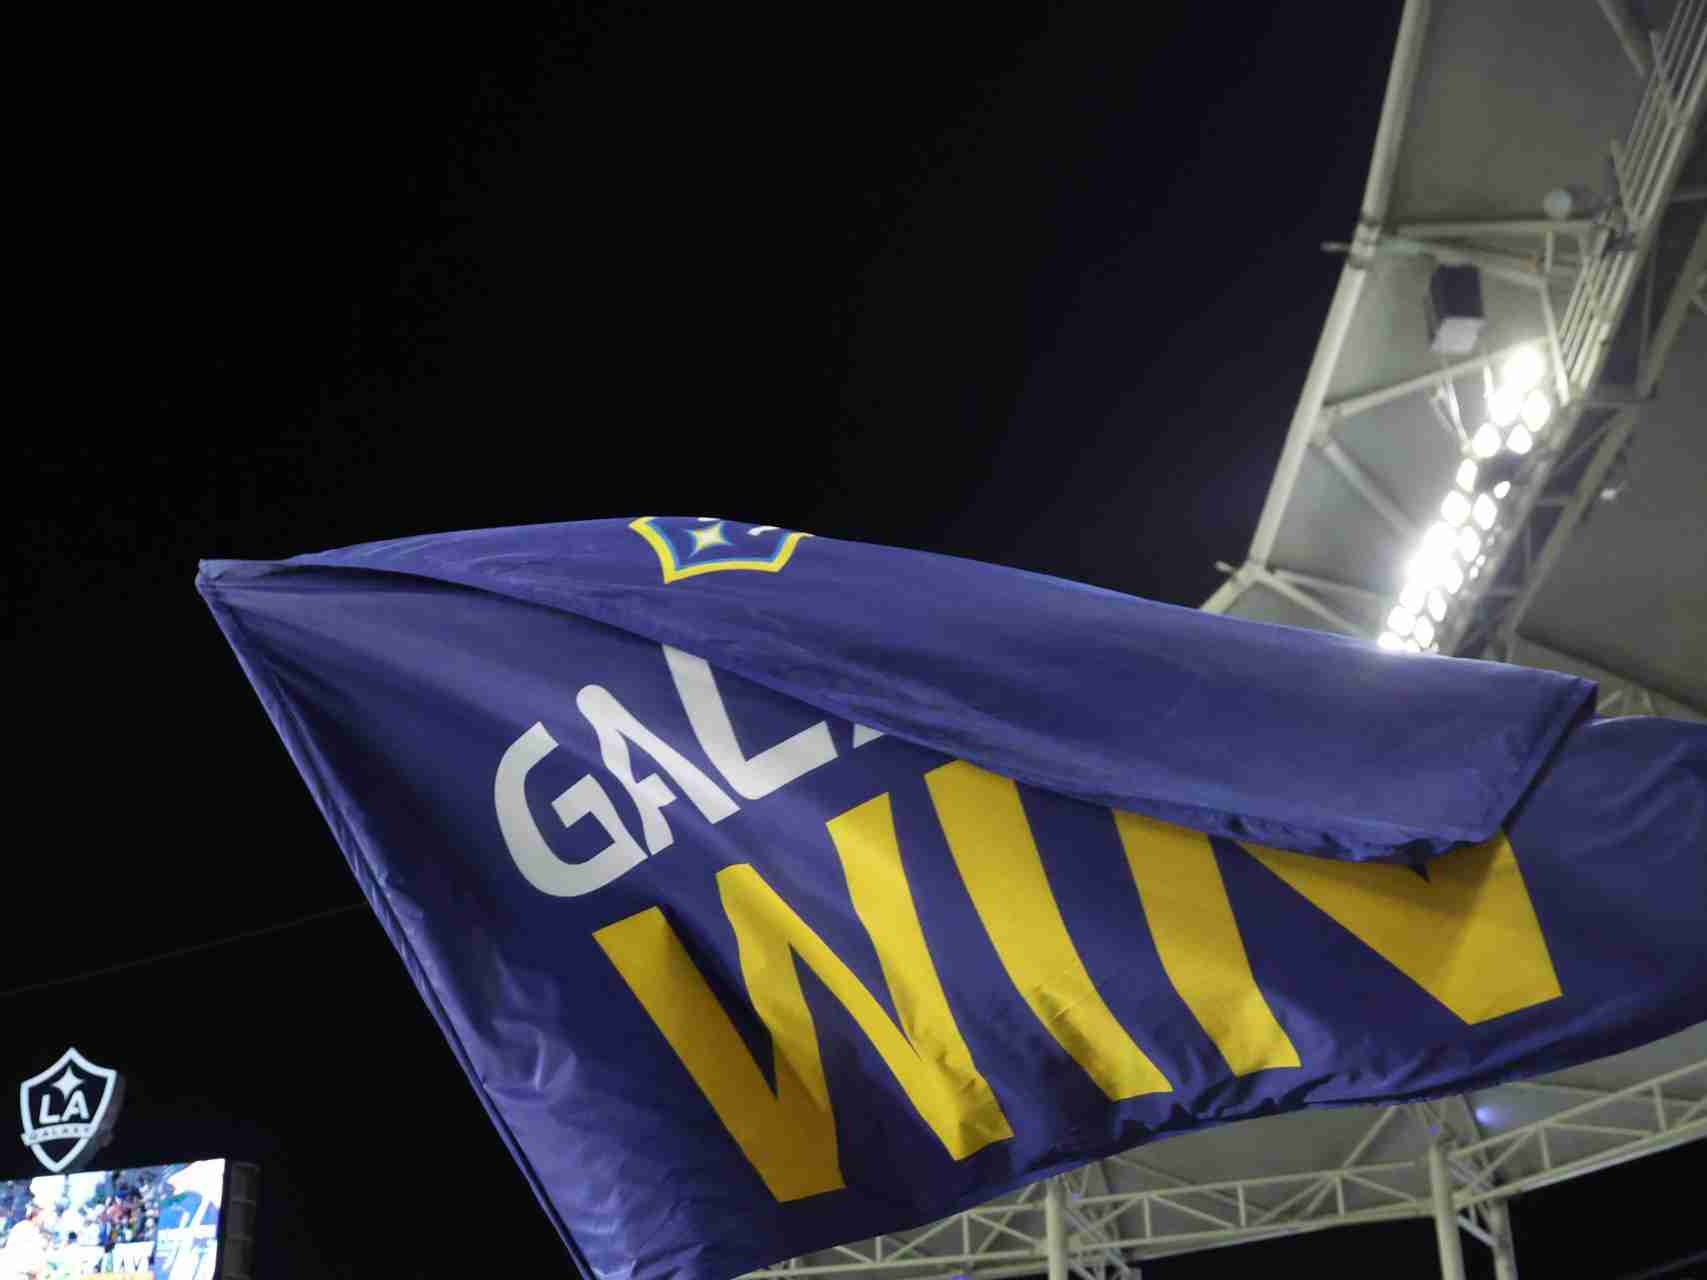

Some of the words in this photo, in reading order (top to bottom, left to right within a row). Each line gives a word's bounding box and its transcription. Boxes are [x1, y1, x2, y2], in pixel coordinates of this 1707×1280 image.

[494, 643, 885, 897] GAL
[39, 1089, 90, 1124] LA
[592, 757, 1562, 1202] WIN
